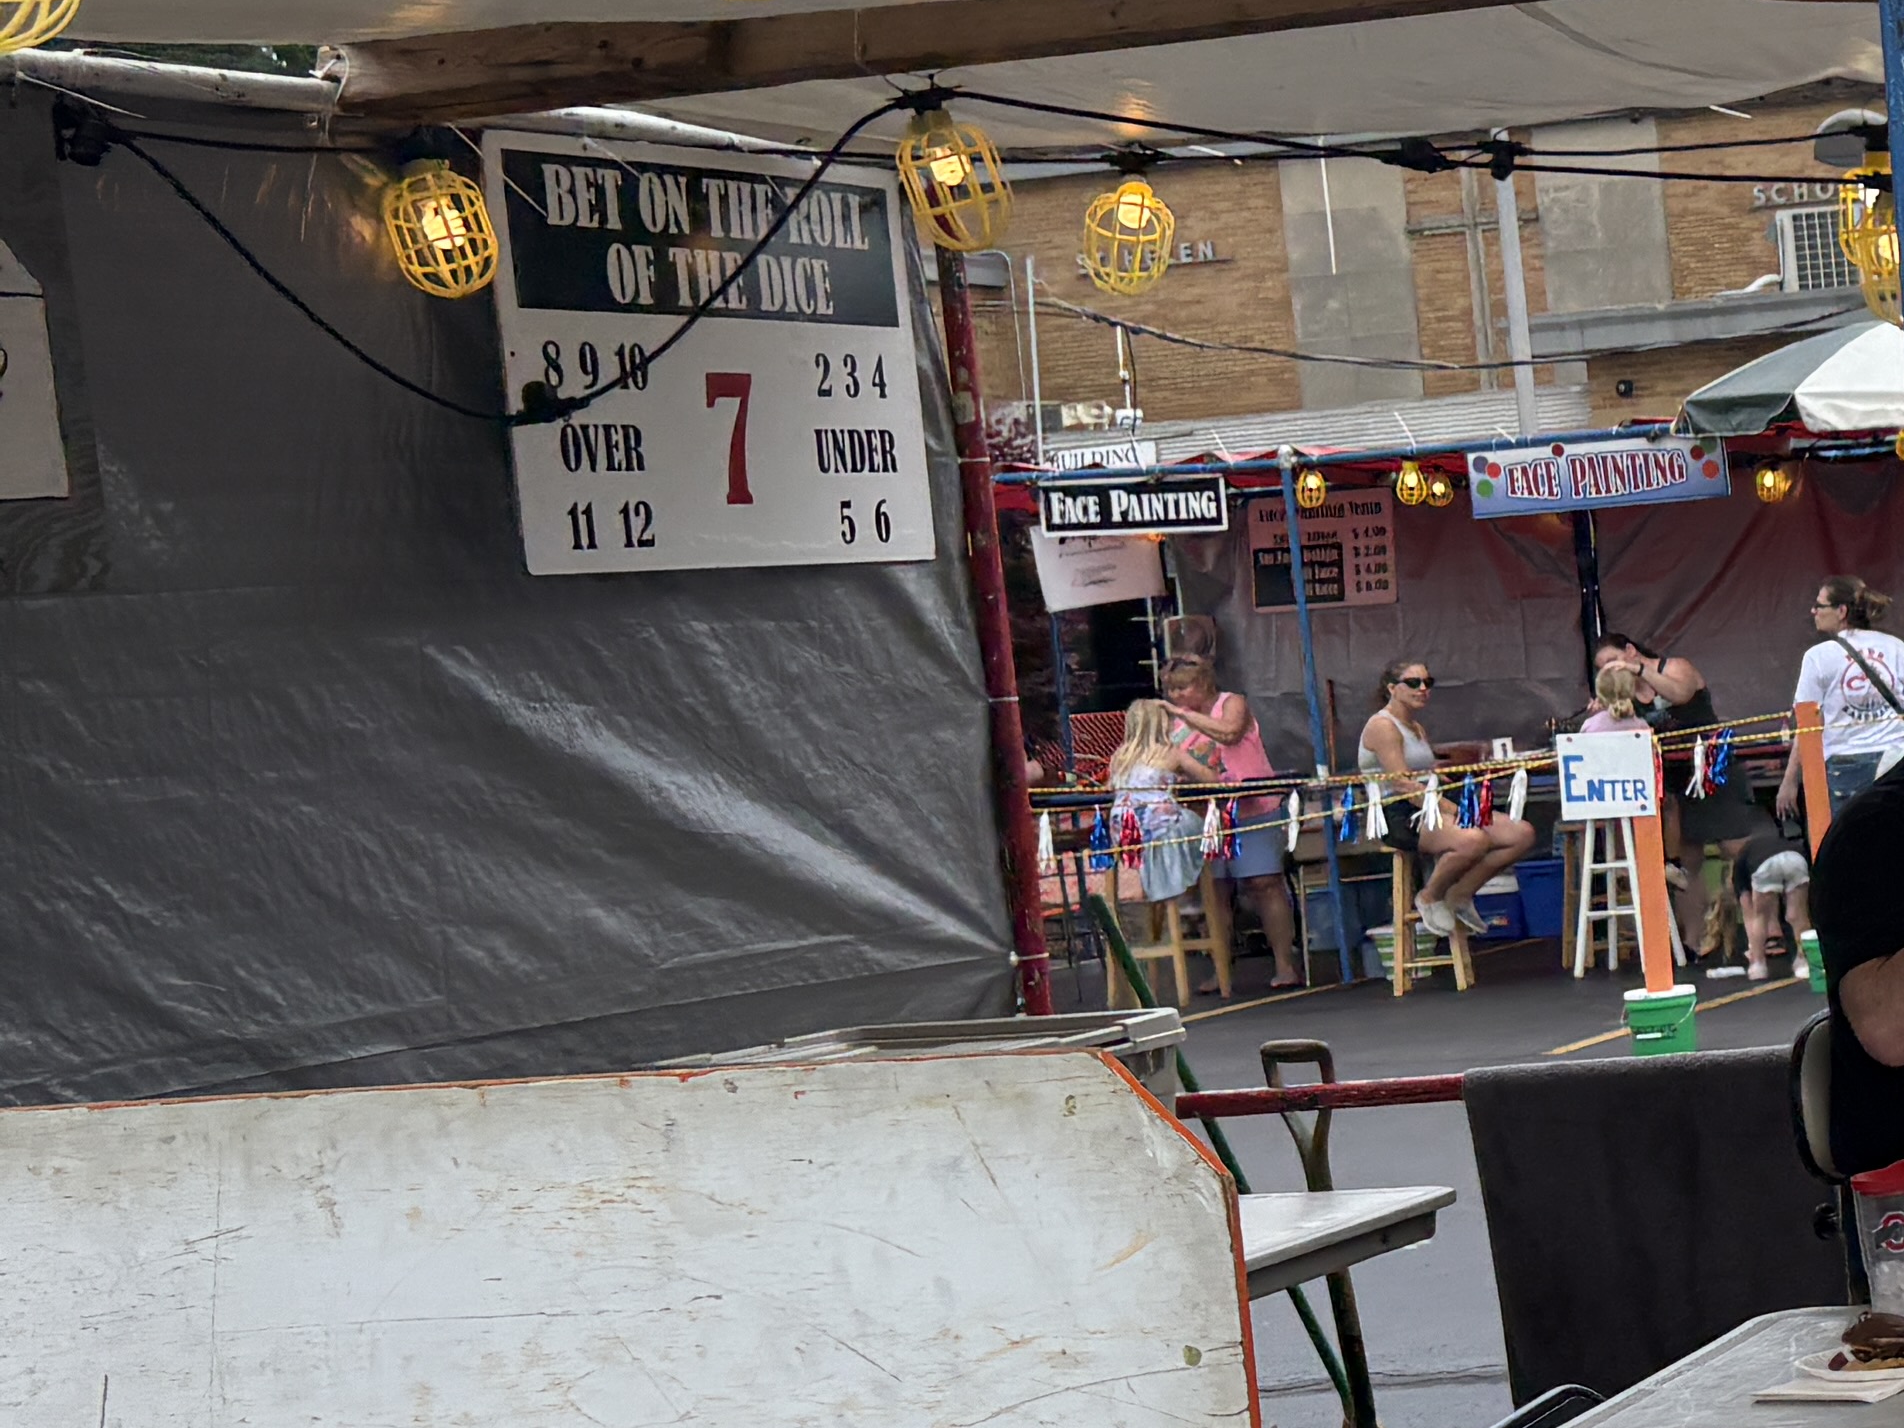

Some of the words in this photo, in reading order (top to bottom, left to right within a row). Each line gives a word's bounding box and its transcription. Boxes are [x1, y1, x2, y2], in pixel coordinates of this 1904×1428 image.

[542, 163, 622, 230] BET
[637, 171, 691, 235] ON
[702, 177, 774, 243] THE
[785, 185, 869, 251] ROLL
[606, 242, 656, 306] OF
[668, 246, 747, 311] THE
[757, 254, 834, 316] DICE
[541, 340, 564, 389] 8
[579, 341, 600, 390] 9
[614, 342, 649, 391] 10
[814, 352, 833, 398] 2
[842, 353, 861, 399] 3
[870, 353, 888, 400] 4
[560, 423, 646, 472] OVER
[814, 428, 899, 474] UNDER
[705, 372, 754, 504] 7
[1505, 458, 1561, 499] FACE
[1568, 449, 1688, 499] PAINTING
[567, 500, 599, 551] 11
[618, 500, 656, 549] 12
[839, 499, 857, 545] 5
[874, 497, 892, 544] 6
[1049, 491, 1100, 525] FACE
[1109, 488, 1217, 522] PAINTING
